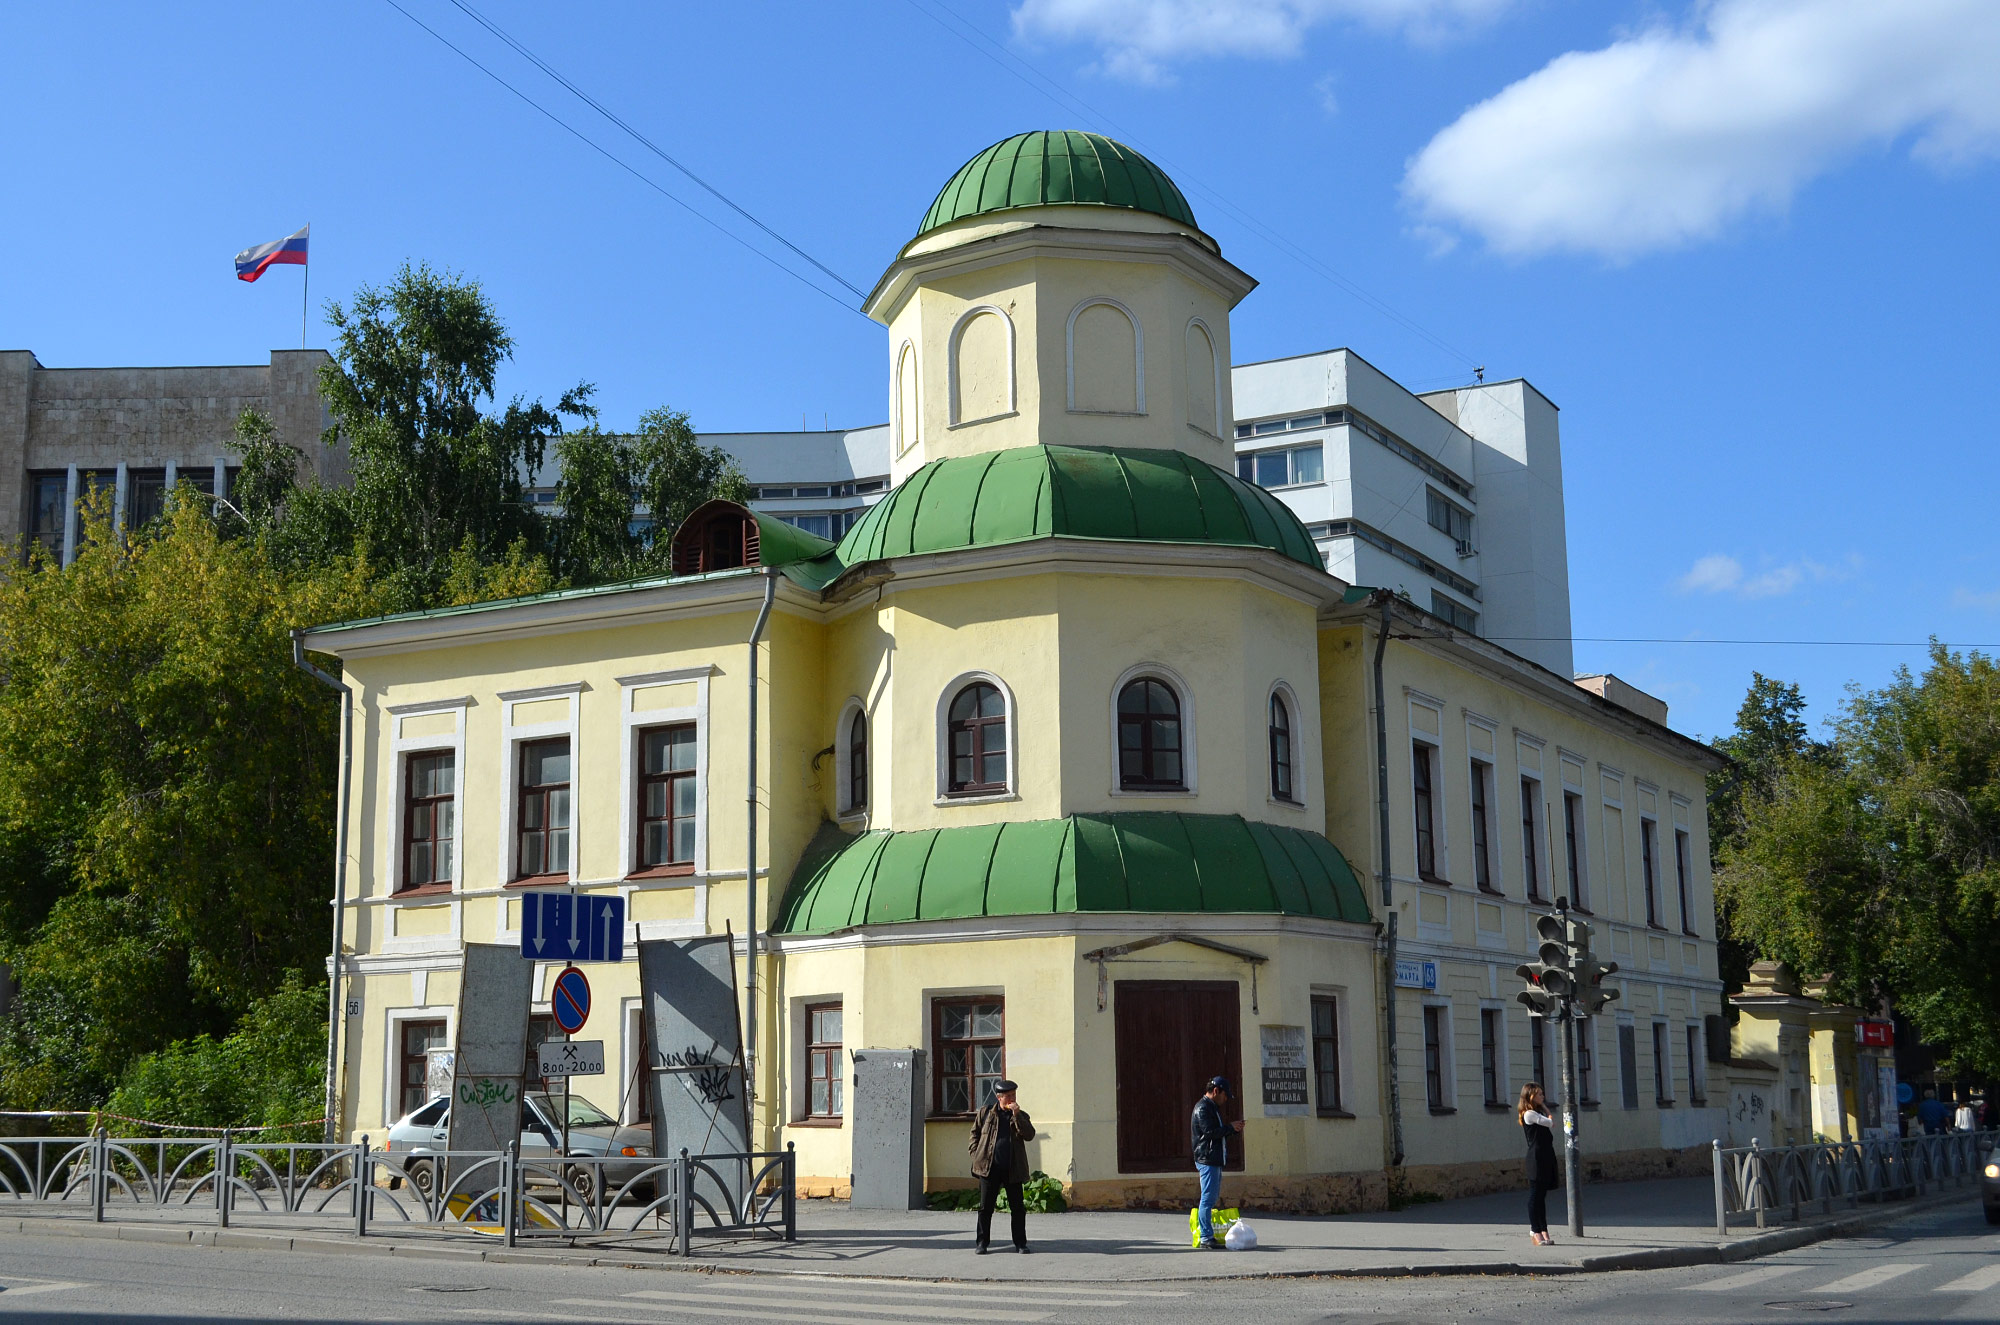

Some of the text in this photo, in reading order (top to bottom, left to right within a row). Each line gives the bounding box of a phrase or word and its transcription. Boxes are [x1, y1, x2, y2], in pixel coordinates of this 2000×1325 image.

[1399, 972, 1419, 982] МАРТА
[1426, 967, 1435, 983] 68
[349, 1001, 359, 1015] 56
[1268, 1069, 1301, 1079] ИНСТИТУТ
[1265, 1081, 1306, 1090] ФИЛОСОФИИ
[1271, 1093, 1301, 1102] И ПРАВА
